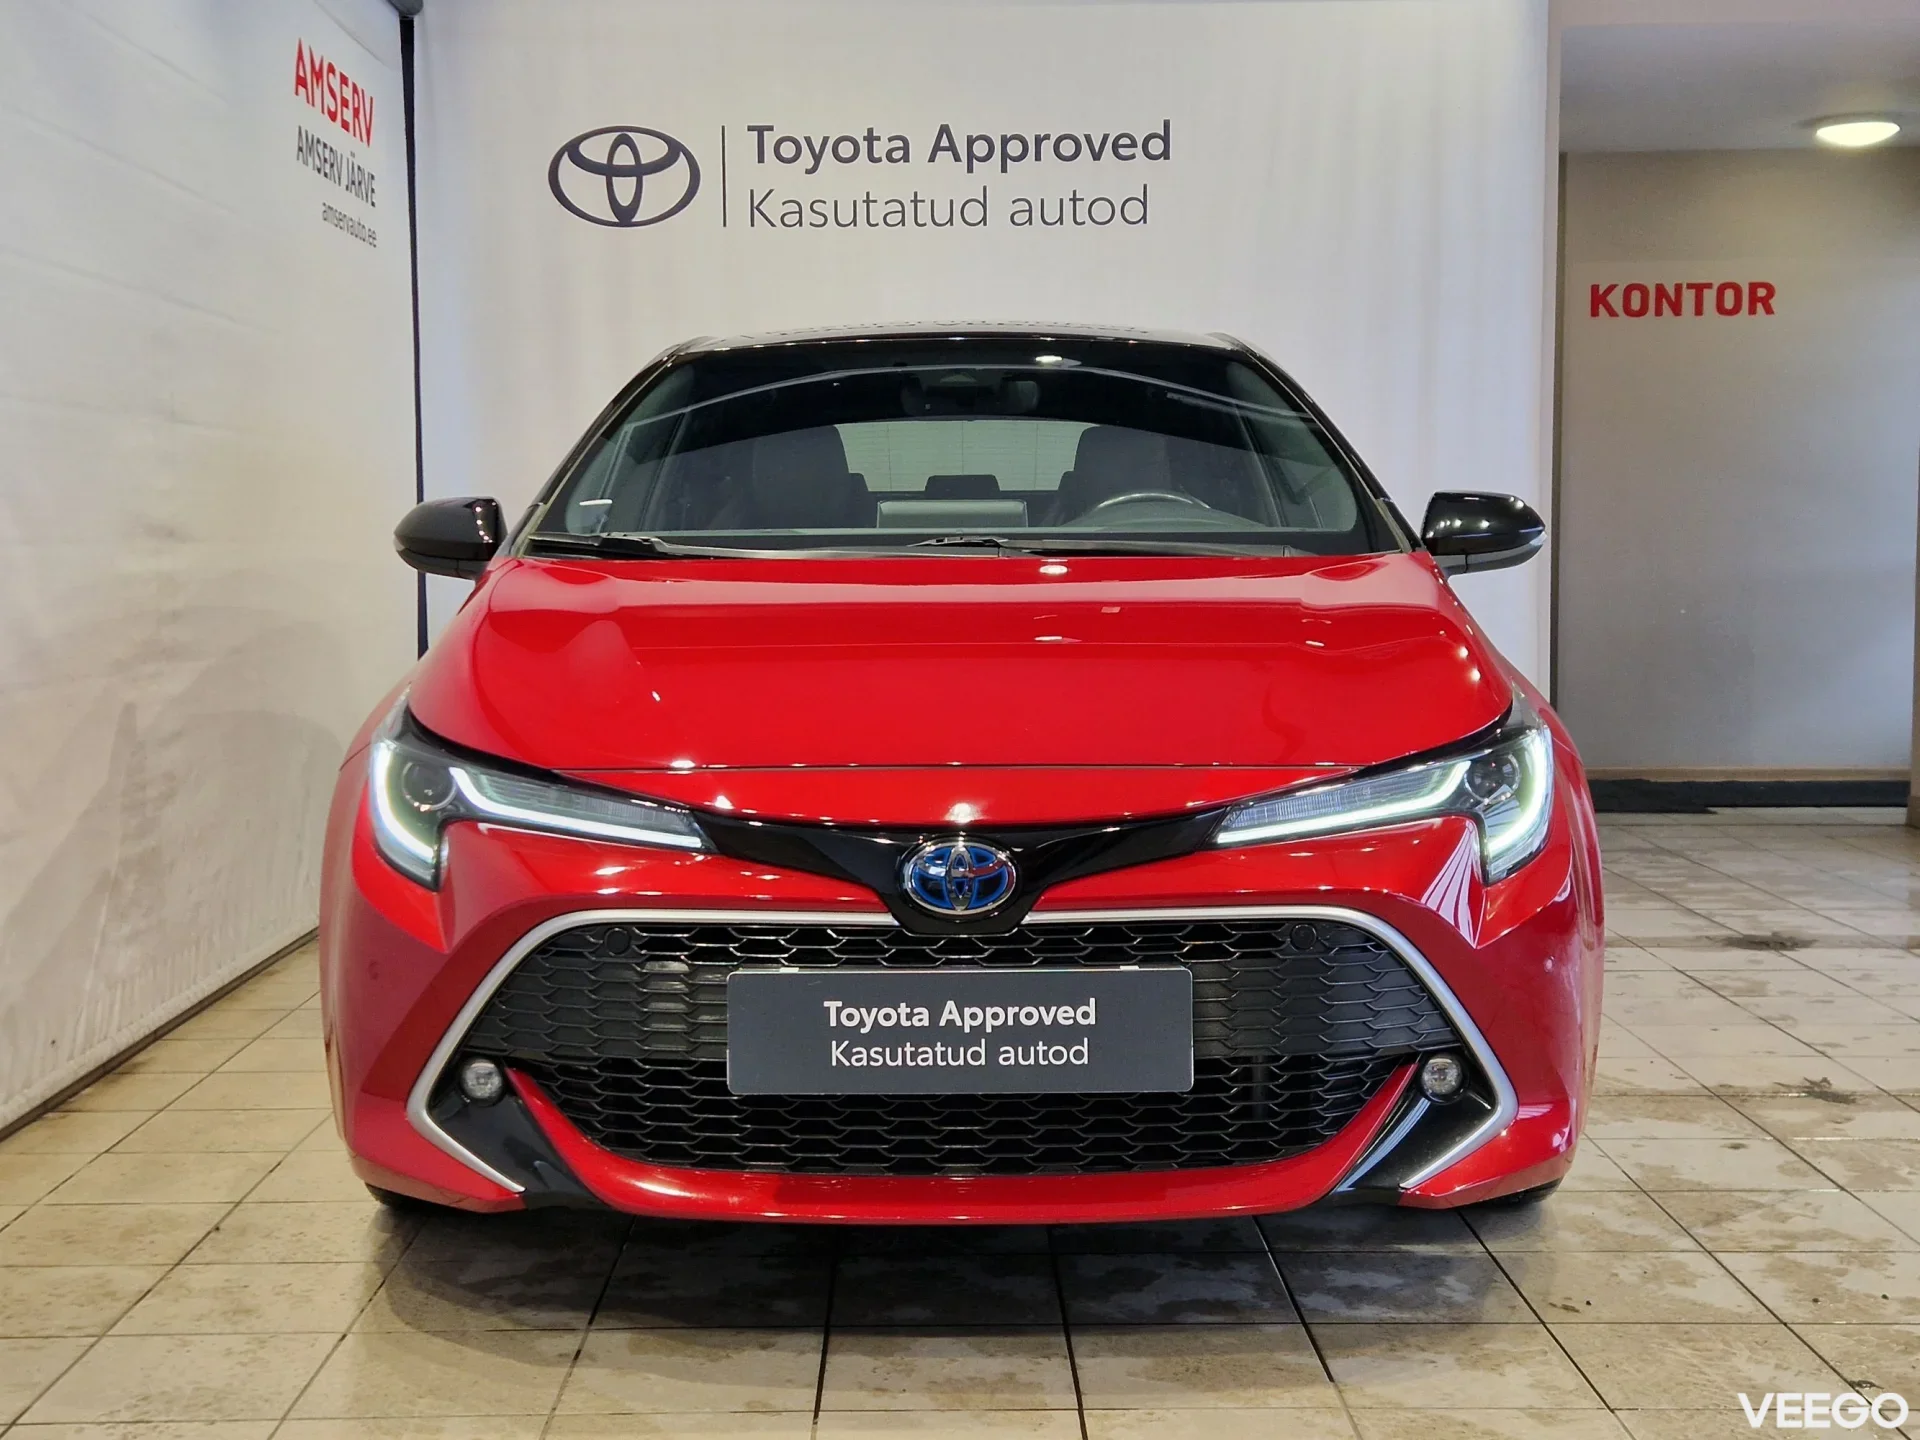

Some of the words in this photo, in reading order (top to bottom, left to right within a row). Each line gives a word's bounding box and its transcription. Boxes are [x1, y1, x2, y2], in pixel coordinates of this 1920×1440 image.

[295, 37, 374, 148] AMSERV
[296, 125, 344, 187] AMSERV
[345, 151, 376, 207] JÄRVE
[747, 124, 911, 174] Toyota
[927, 119, 1172, 174] Approved
[322, 202, 377, 248] amservauto.ee
[747, 185, 988, 229] Kasutatud
[1009, 183, 1149, 226] autod
[1590, 282, 1776, 318] KONTOR
[823, 1001, 930, 1033] Toyota
[939, 998, 1096, 1033] Approved
[831, 1038, 986, 1067] Kasutatud
[998, 1037, 1089, 1065] autod
